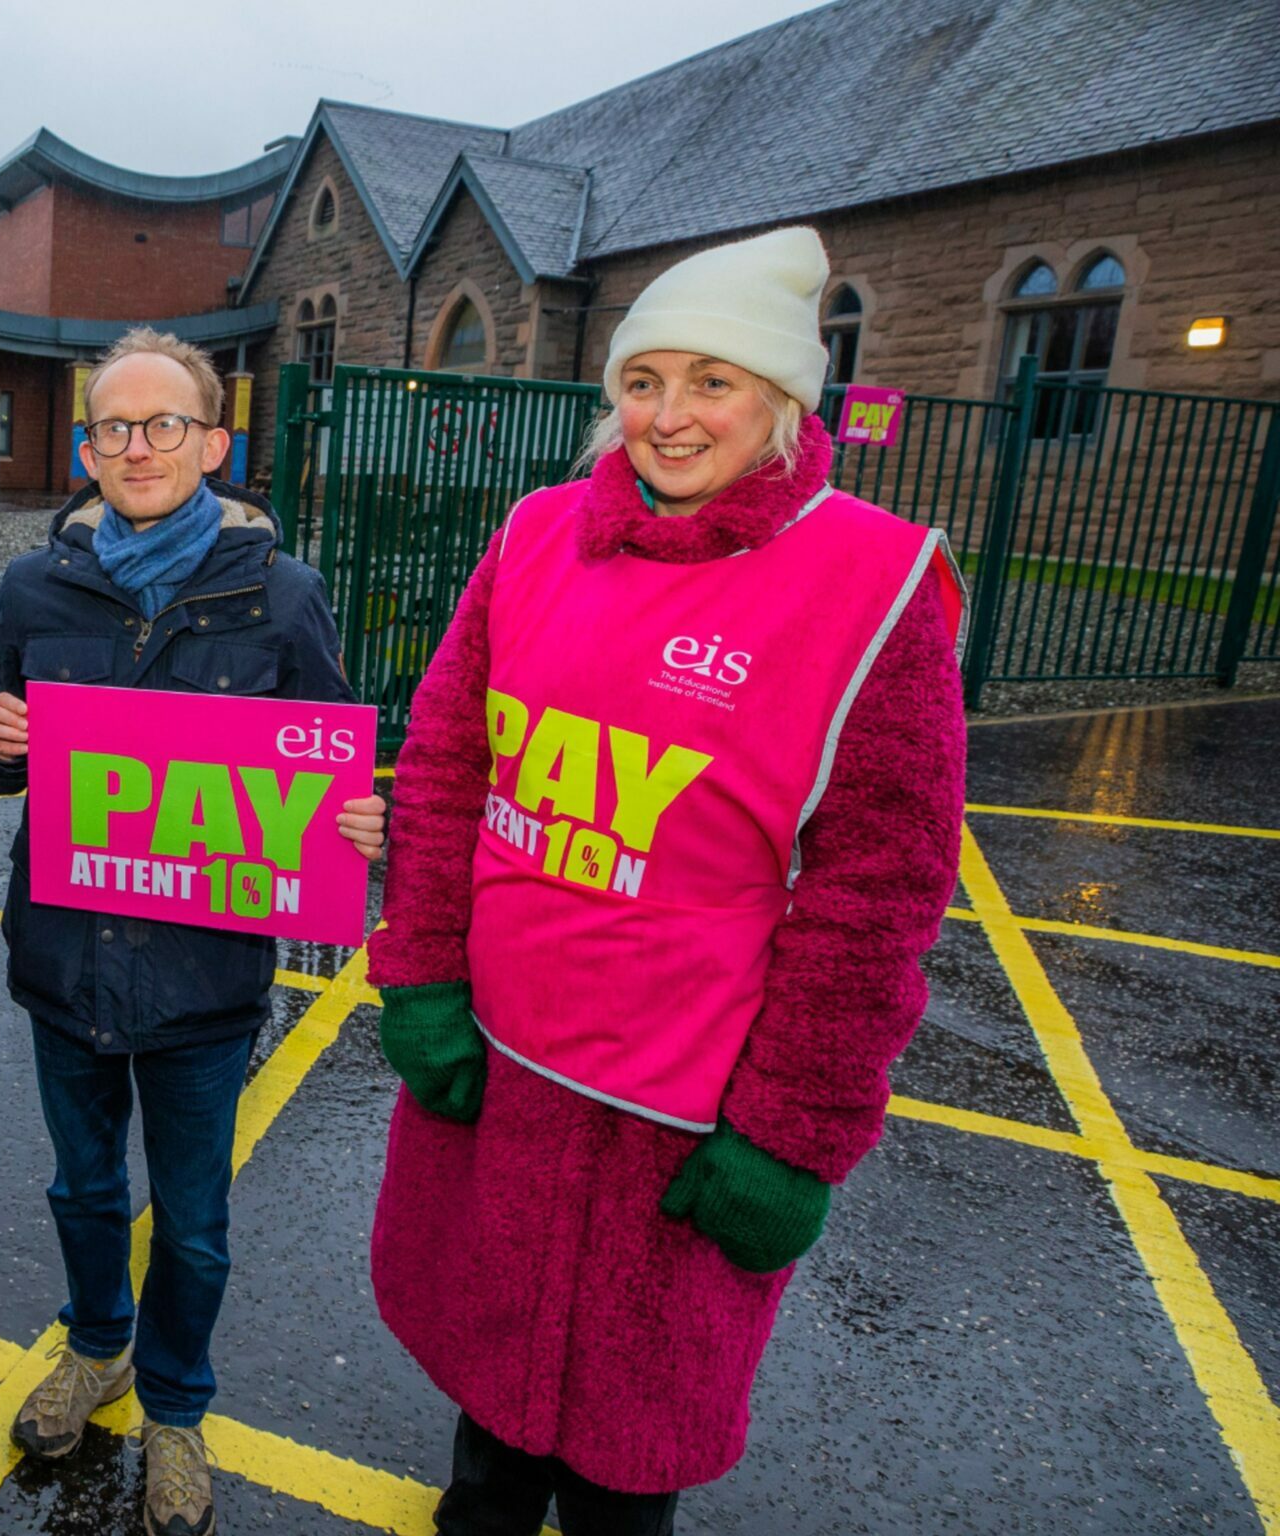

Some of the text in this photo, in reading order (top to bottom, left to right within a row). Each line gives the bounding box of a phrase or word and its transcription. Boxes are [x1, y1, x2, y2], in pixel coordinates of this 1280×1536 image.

[848, 401, 896, 430] PAY
[662, 634, 753, 686] eis
[647, 678, 736, 712] Institute of Scotland
[660, 670, 731, 698] The Educational
[276, 717, 356, 763] eis
[485, 687, 715, 853] PAY
[69, 750, 336, 872] PAY
